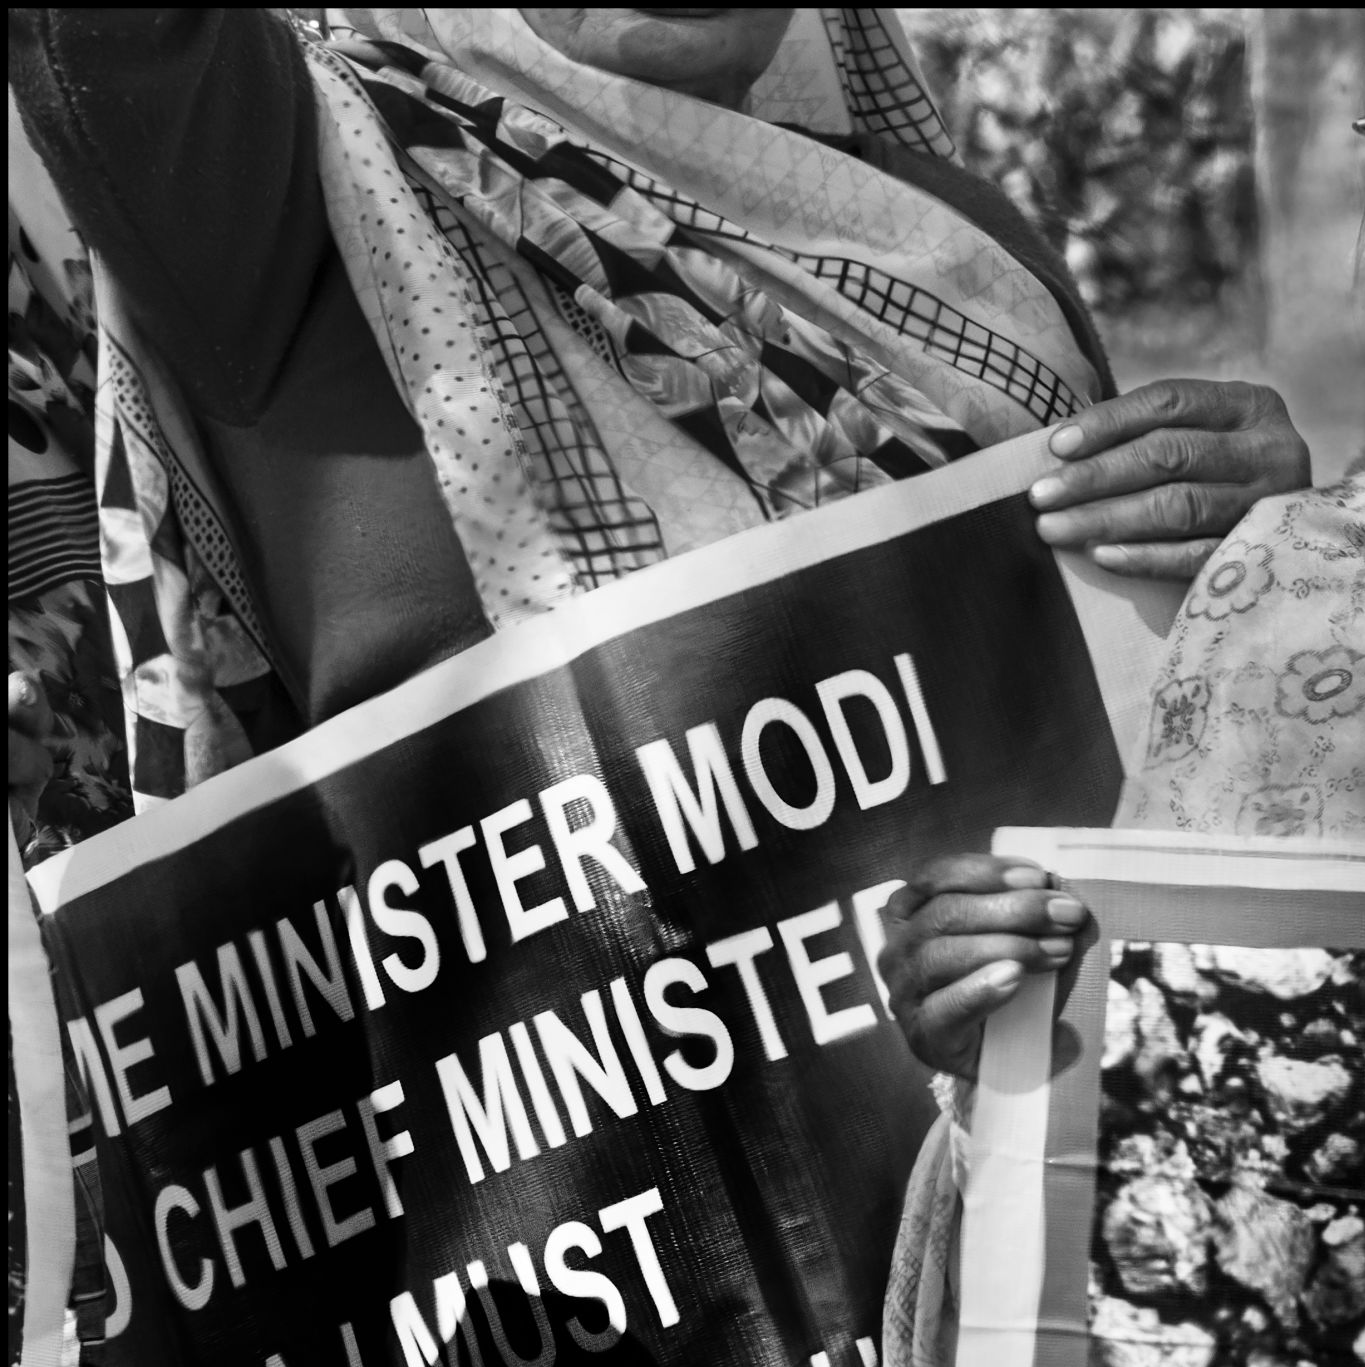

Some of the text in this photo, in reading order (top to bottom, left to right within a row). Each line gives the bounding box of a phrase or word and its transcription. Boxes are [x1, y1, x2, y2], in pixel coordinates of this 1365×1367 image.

[174, 774, 646, 1086] MINISTER
[635, 653, 946, 874] MODI
[154, 1081, 416, 1311] CHIEF
